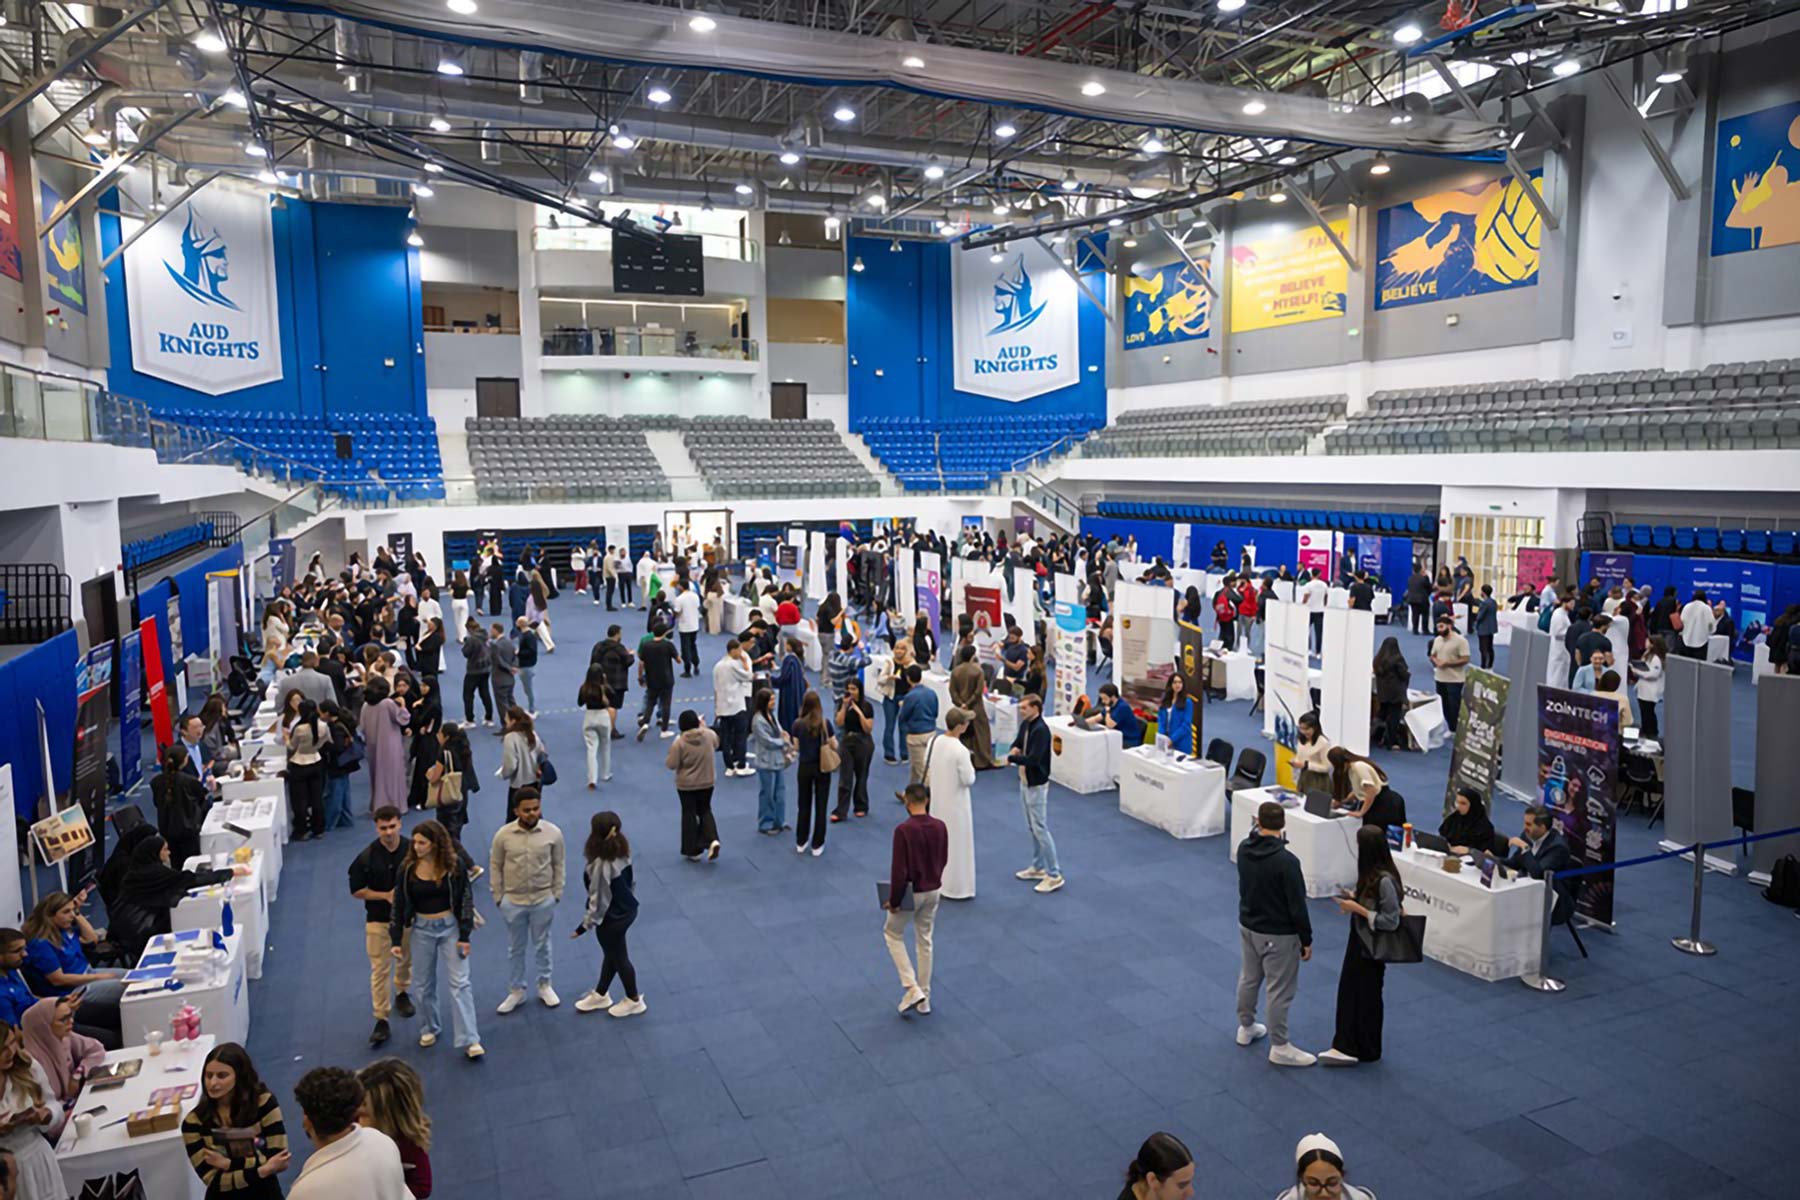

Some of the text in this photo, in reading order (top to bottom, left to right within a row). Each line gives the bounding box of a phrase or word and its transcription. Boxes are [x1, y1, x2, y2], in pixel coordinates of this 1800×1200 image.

[1279, 275, 1326, 294] BELIEVE
[1381, 279, 1438, 304] BELIEVE
[188, 322, 230, 341] AUD
[158, 331, 260, 360] KNIGHTS
[997, 345, 1032, 360] AUD
[974, 353, 1059, 374] KNIGHTS
